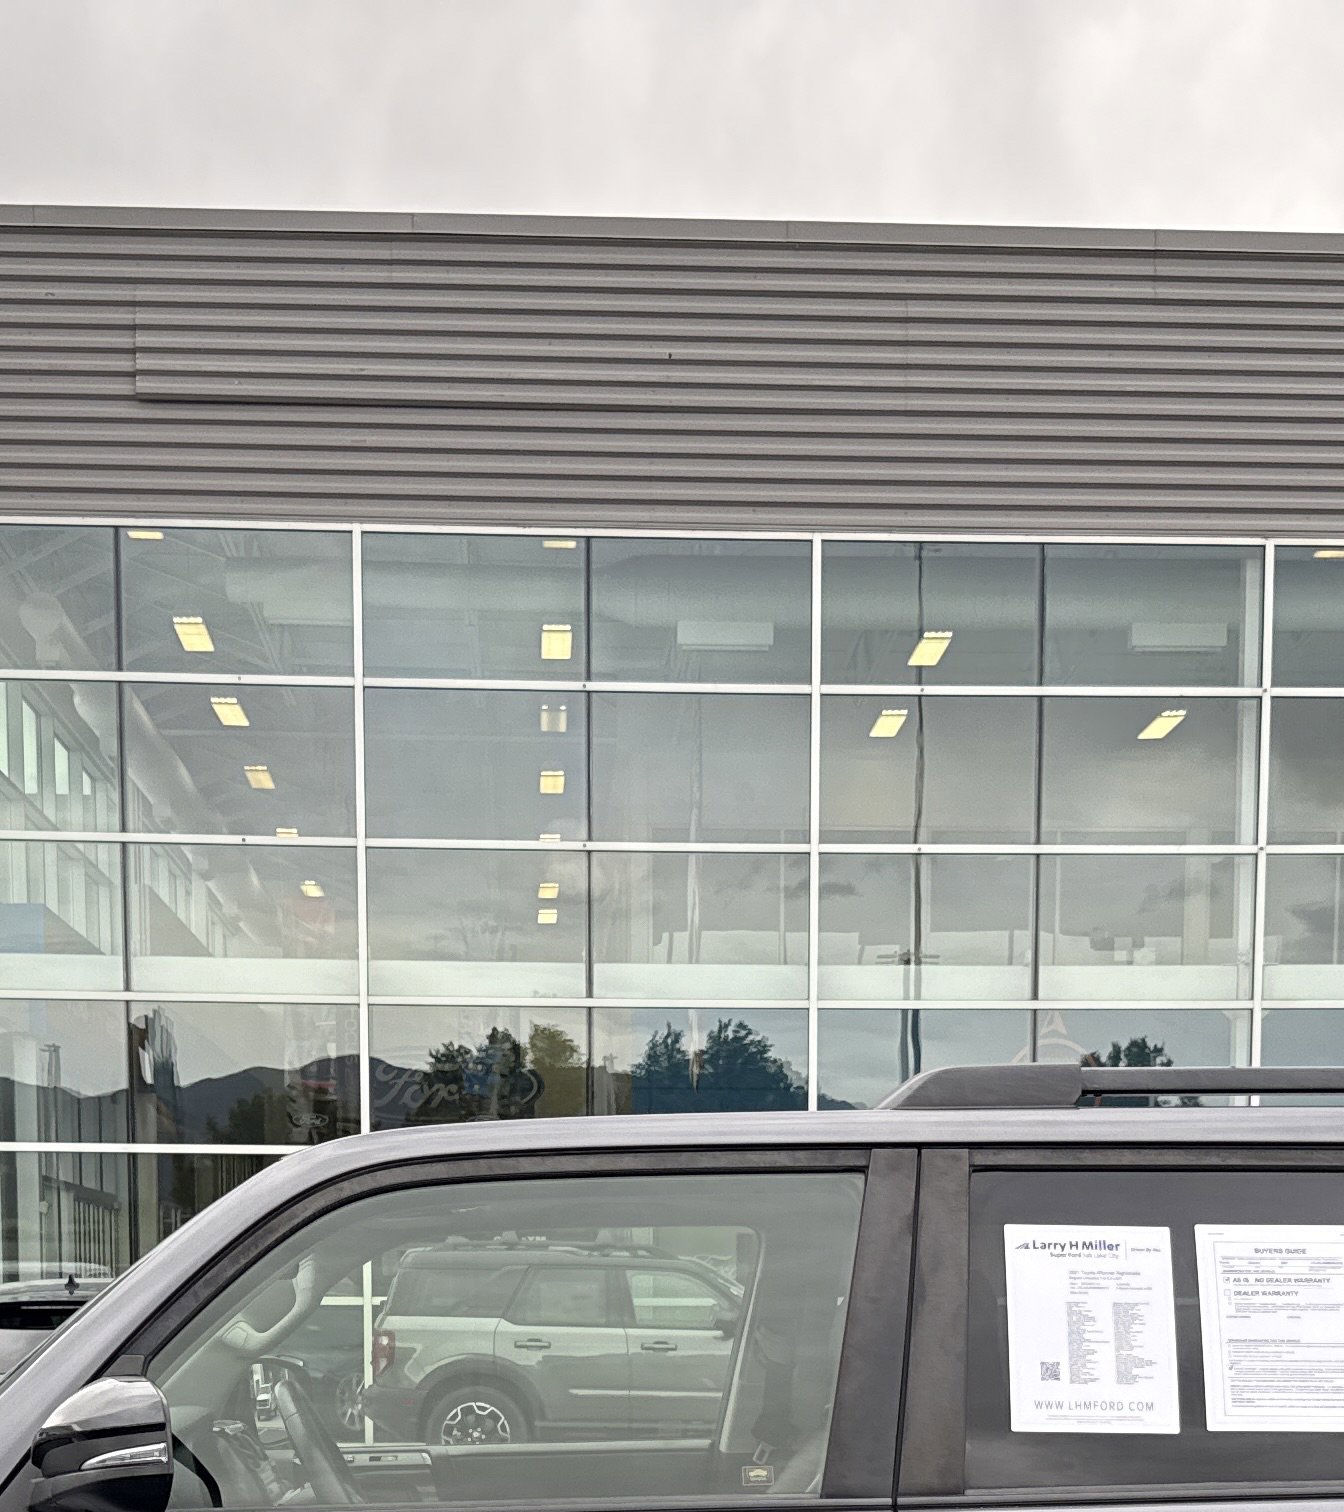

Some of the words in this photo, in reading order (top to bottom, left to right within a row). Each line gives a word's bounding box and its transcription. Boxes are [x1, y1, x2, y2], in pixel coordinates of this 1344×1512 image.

[1032, 1240, 1067, 1252] Larry
[1069, 1241, 1079, 1250] H
[1081, 1240, 1121, 1251] Miller
